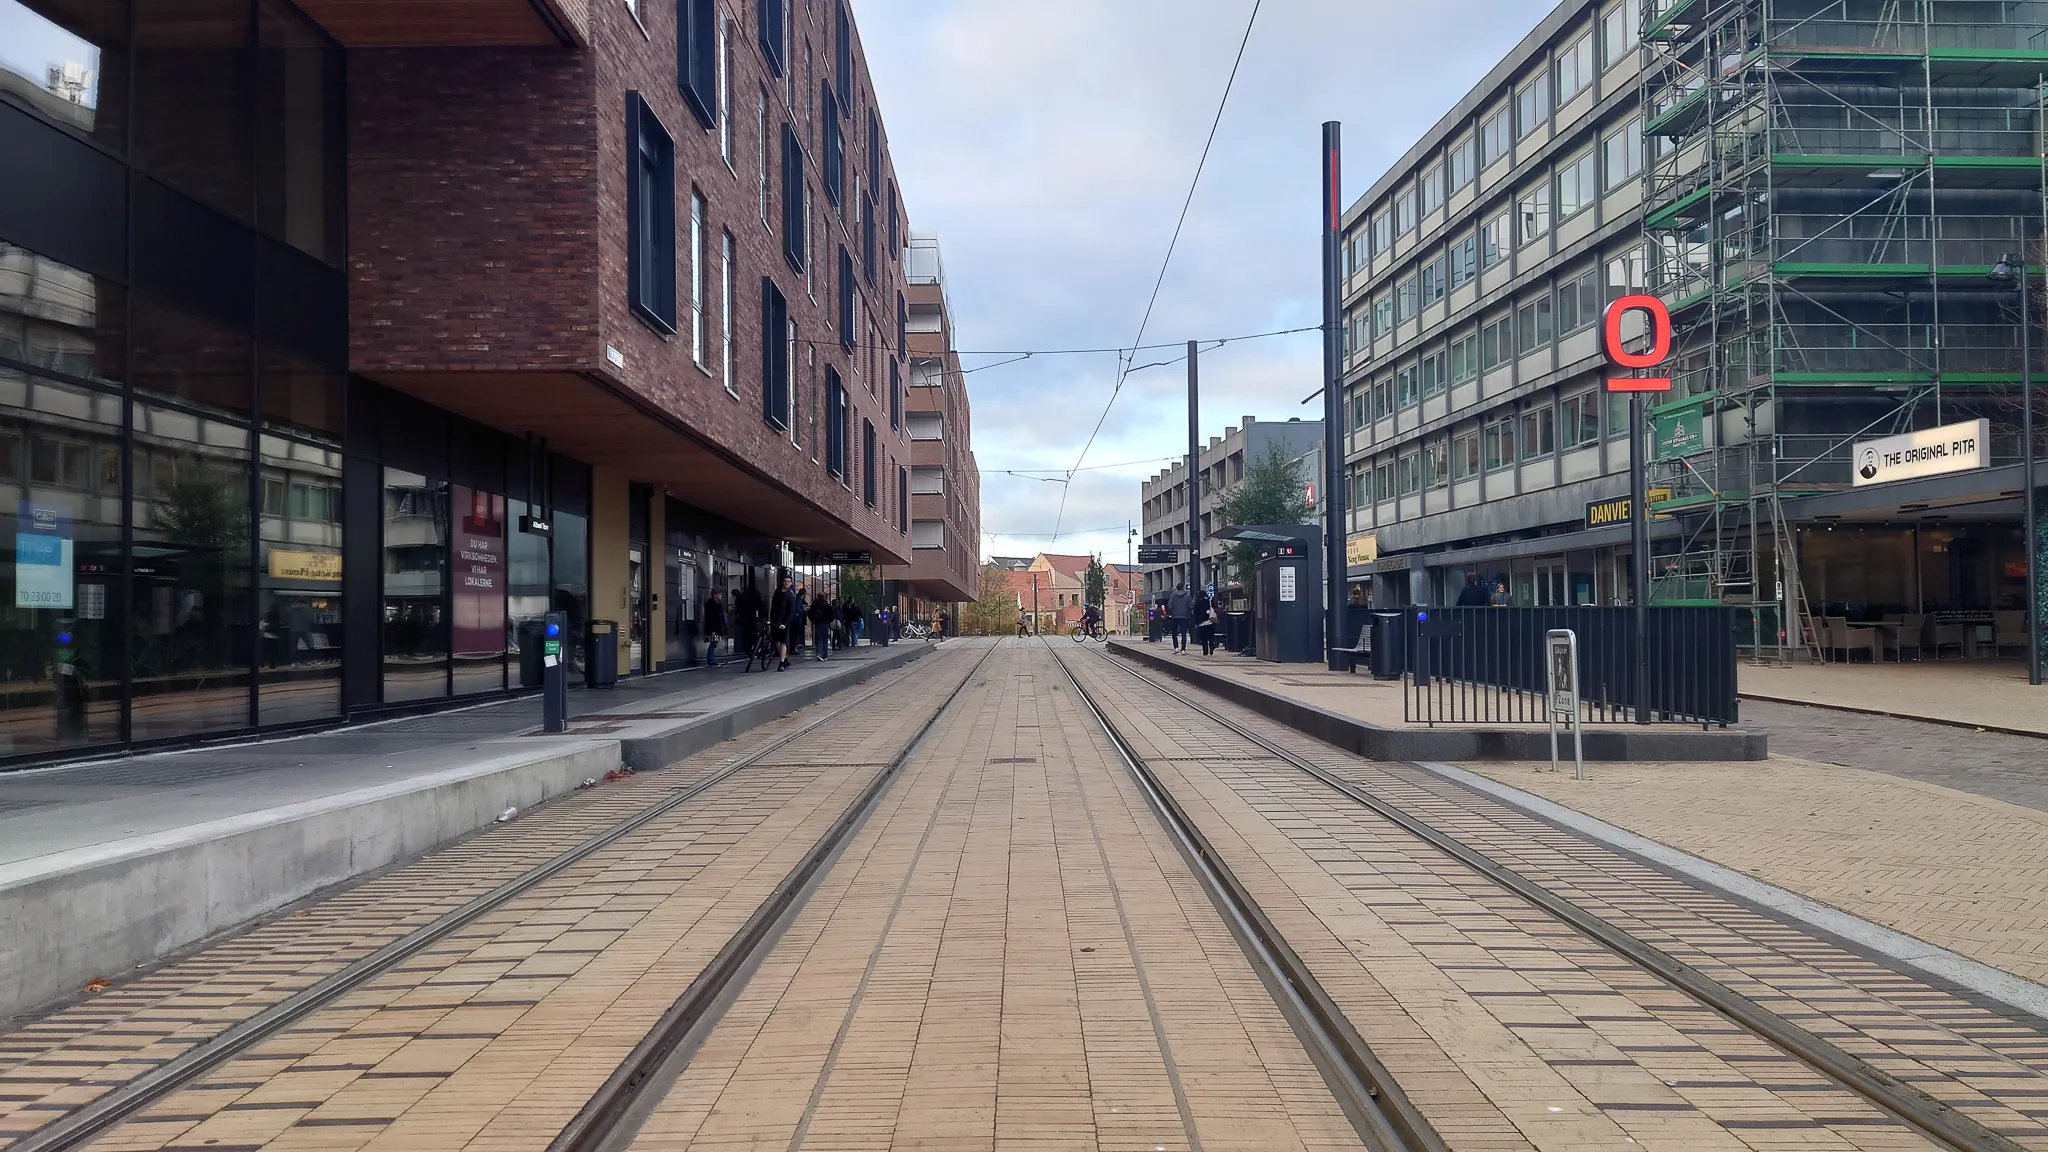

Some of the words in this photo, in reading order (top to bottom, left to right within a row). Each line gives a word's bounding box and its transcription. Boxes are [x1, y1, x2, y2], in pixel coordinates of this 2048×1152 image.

[1884, 452, 1901, 467] THE
[1905, 444, 1948, 463] ORIGINAL
[1952, 438, 1975, 456] PITA
[470, 539, 477, 549] DU
[477, 540, 488, 550] HAR
[477, 565, 487, 575] HAR
[20, 591, 28, 601] 70
[29, 592, 40, 602] 23
[41, 592, 51, 602] 00
[52, 592, 62, 602] 20
[1558, 694, 1571, 706] Zone
